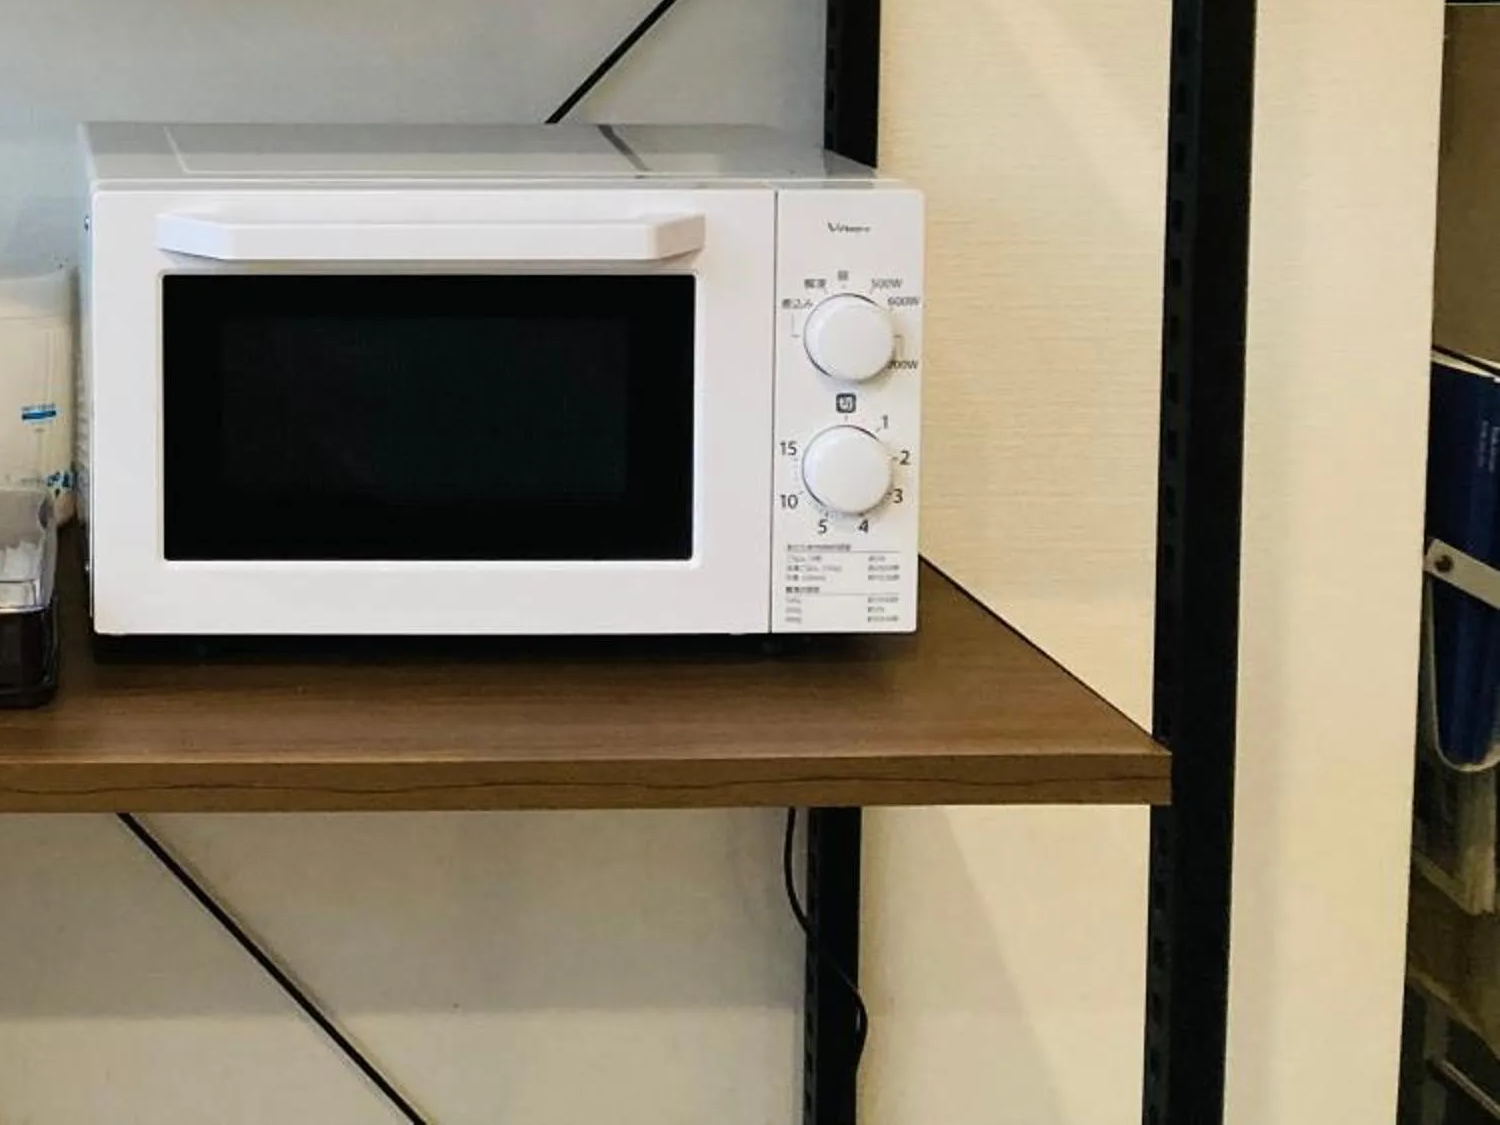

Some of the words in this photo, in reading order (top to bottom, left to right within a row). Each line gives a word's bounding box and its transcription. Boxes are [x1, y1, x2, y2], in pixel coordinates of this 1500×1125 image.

[882, 415, 889, 428] 1
[780, 441, 797, 455] 15
[900, 450, 910, 465] 2
[780, 494, 798, 509] 10
[893, 489, 903, 503] 3
[818, 519, 828, 534] 5
[858, 519, 869, 534] 4
